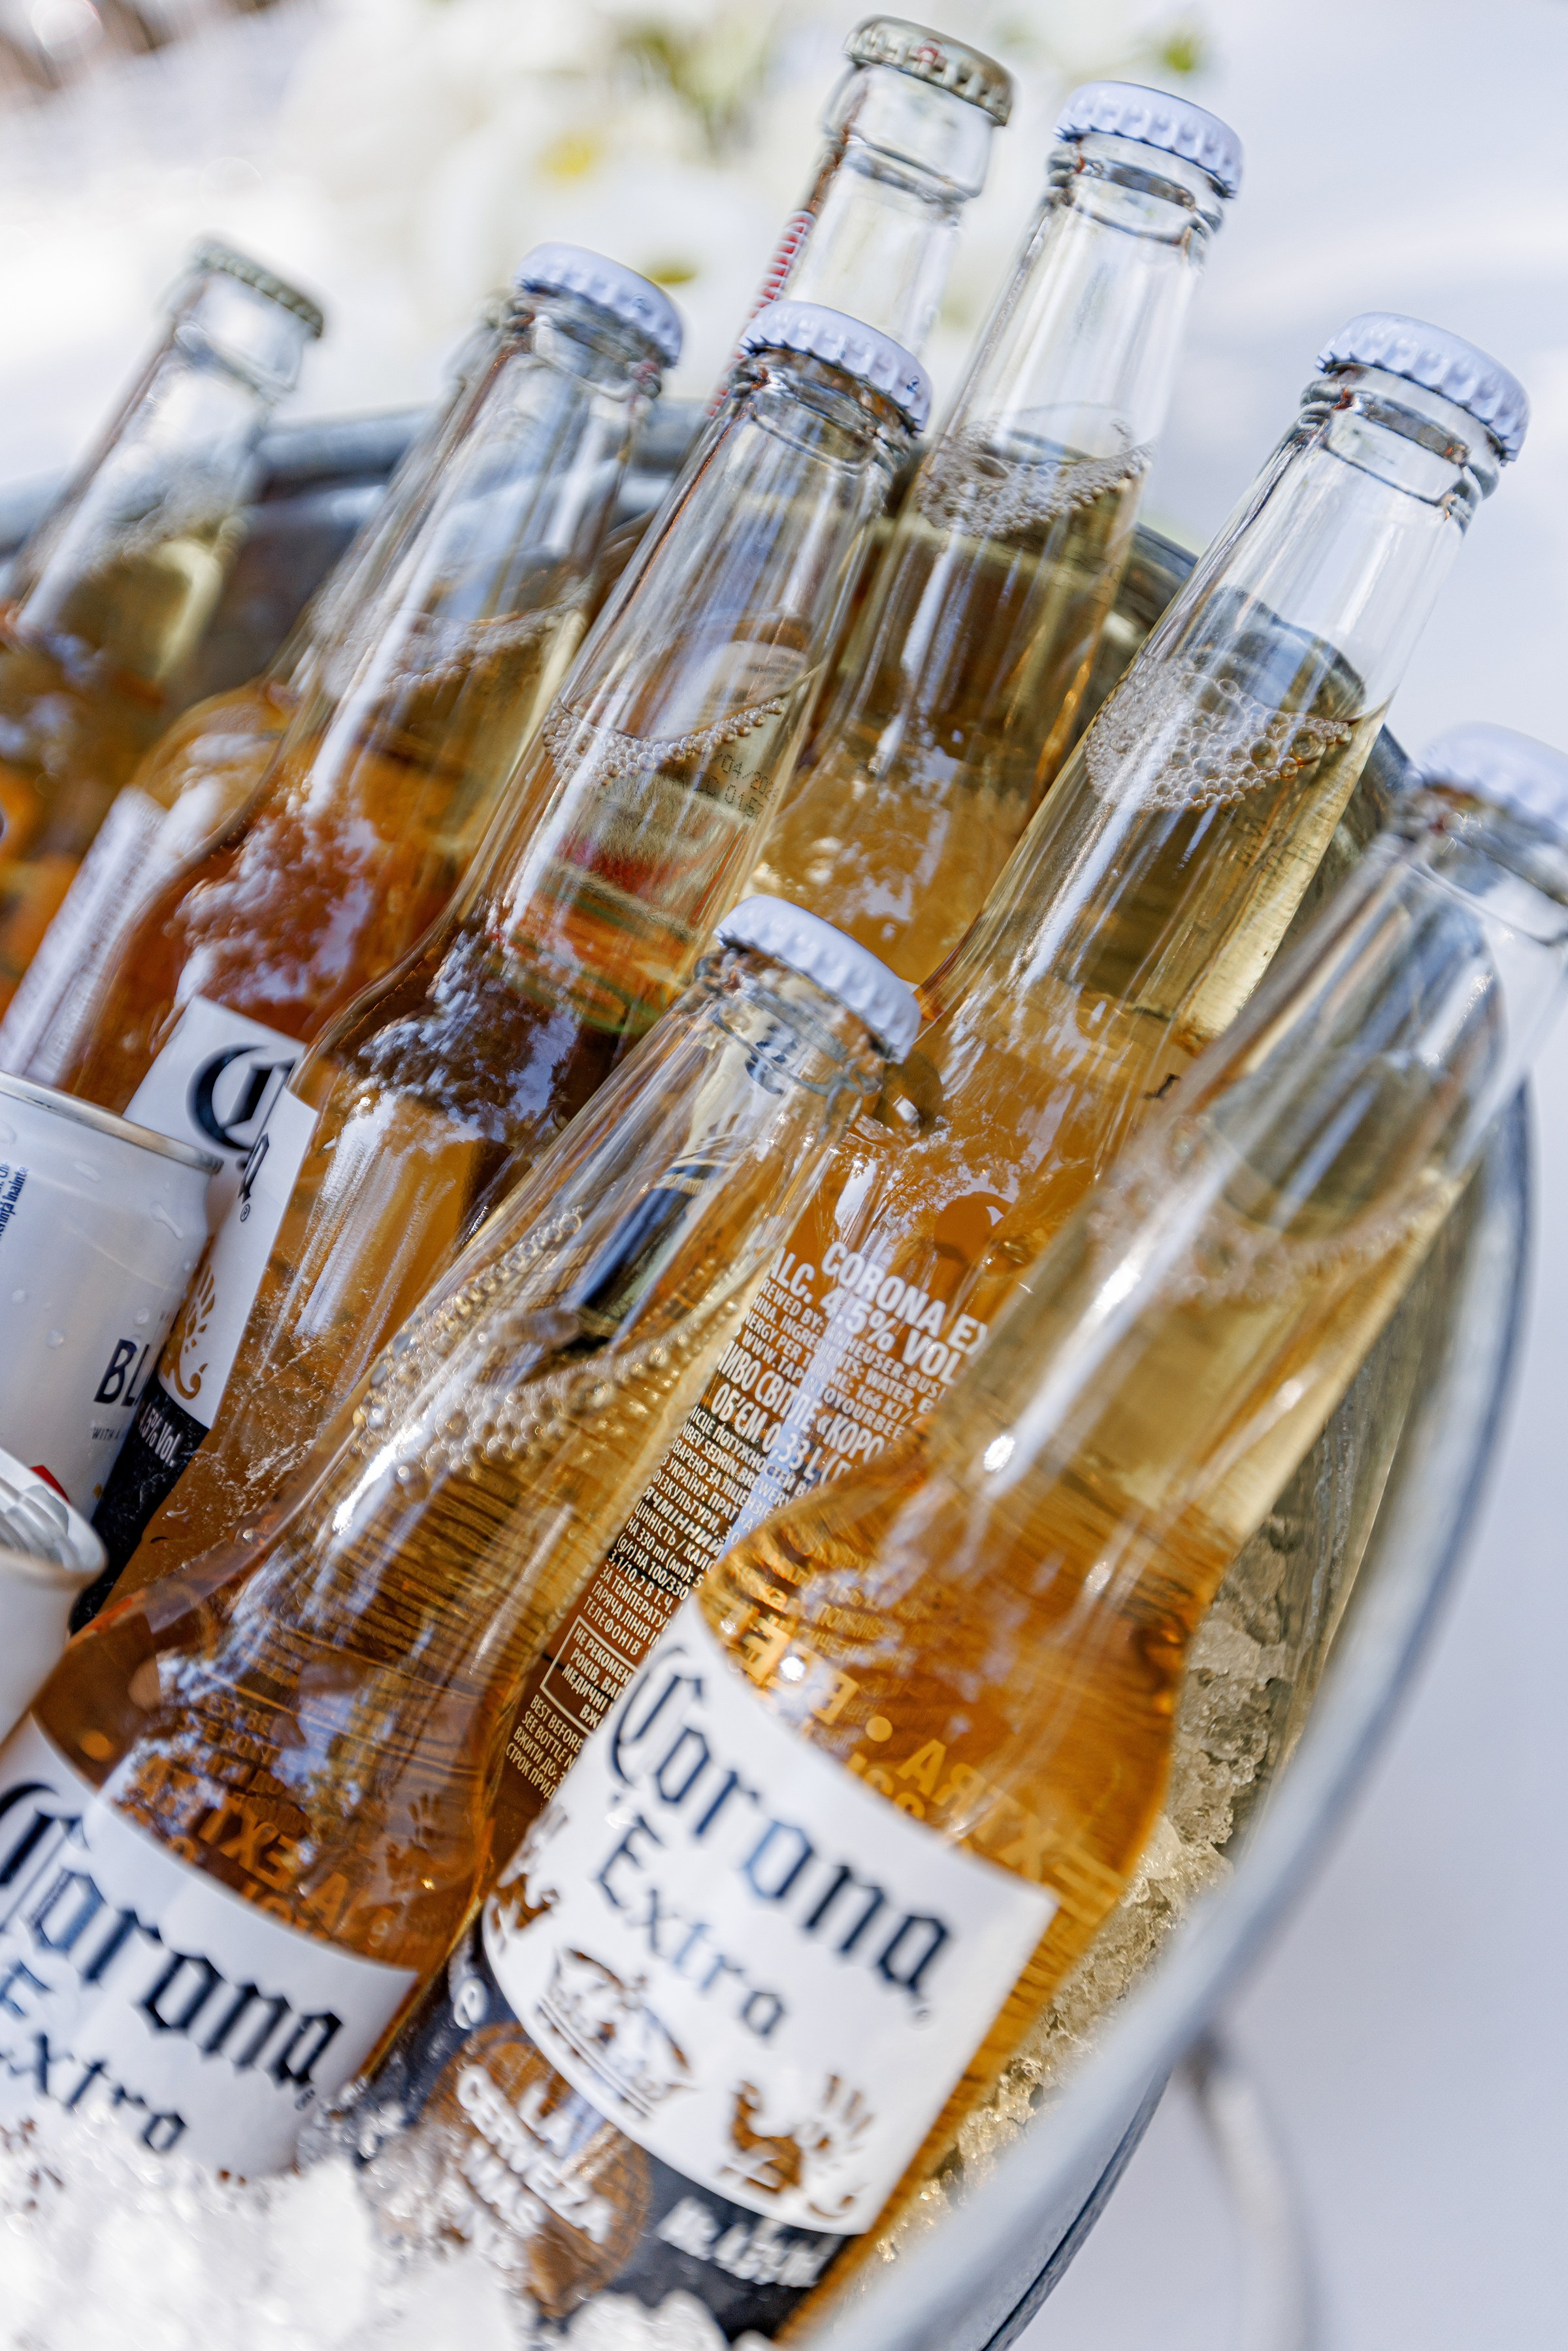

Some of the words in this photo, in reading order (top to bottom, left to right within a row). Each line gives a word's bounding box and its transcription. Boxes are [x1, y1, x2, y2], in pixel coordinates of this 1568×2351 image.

[770, 1246, 815, 1305] ALC.
[819, 1287, 897, 1353] 4.5%
[902, 1328, 962, 1386] VOL
[821, 1241, 947, 1338] CORONA
[775, 1334, 802, 1362] PER
[802, 1351, 828, 1377] 100
[828, 1370, 854, 1395] ML:
[855, 1384, 884, 1410] 166
[882, 1398, 904, 1420] KJ
[778, 1314, 864, 1379] INGREDIENTS:
[864, 1368, 915, 1410] WATER,
[799, 1307, 825, 1334] BY:
[825, 1324, 947, 1402] ANHEUSER-BUS
[154, 1421, 183, 1468] Vol.
[754, 1370, 823, 1434] СВІТЛЕ
[817, 1412, 887, 1464] «КОРО
[670, 1436, 708, 1477] ЗВАРЕНО
[706, 1467, 721, 1488] ЗА
[700, 1438, 740, 1477] SEDRIN
[712, 1423, 796, 1492] ПОТУЖНОСТЕЙ
[794, 1479, 813, 1498] В
[762, 1422, 810, 1471] 0,33
[803, 1445, 825, 1481] L
[634, 1500, 676, 1547] ЦІННІСТЬ
[642, 1485, 726, 1556] ЯЧМІННИЙ
[652, 1469, 721, 1536] ФІЗКУЛЬТУРИ,
[666, 1457, 709, 1502] УКРАЇНУ:
[708, 1492, 740, 1522] ПРАТ
[738, 1516, 760, 1533] «А
[608, 1548, 646, 1591] 3,1/10,2
[625, 1516, 640, 1537] НА
[636, 1527, 655, 1551] 330
[653, 1544, 670, 1562] ml
[600, 1564, 613, 1585] ЗА
[612, 1575, 672, 1634] ТЕМПЕРАТУР
[633, 1549, 649, 1571] НА
[647, 1561, 689, 1601] 100/330
[583, 1595, 643, 1656] ТЕЛЕФОНІВ
[591, 1580, 624, 1619] ГАРЯЧА
[620, 1609, 651, 1641] ЛІНІЯ
[570, 1647, 602, 1688] РОКІВ,
[572, 1626, 588, 1647] НЕ
[587, 1638, 632, 1687] РЕКОМЕН
[561, 1664, 609, 1713] МЕДИЧНІ
[579, 1703, 605, 1732] ВЖ
[513, 1725, 544, 1765] ВЖИТИ
[539, 1756, 557, 1781] ДО:
[521, 1710, 539, 1734] SEE
[533, 1725, 568, 1764] BOTTLE
[530, 1694, 551, 1722] BEST
[547, 1712, 584, 1754] BEFORE
[506, 1742, 532, 1778] СТРОК
[527, 1768, 558, 1804] ПРИД
[605, 1643, 956, 1997] Corona
[593, 1811, 791, 2041] Extra
